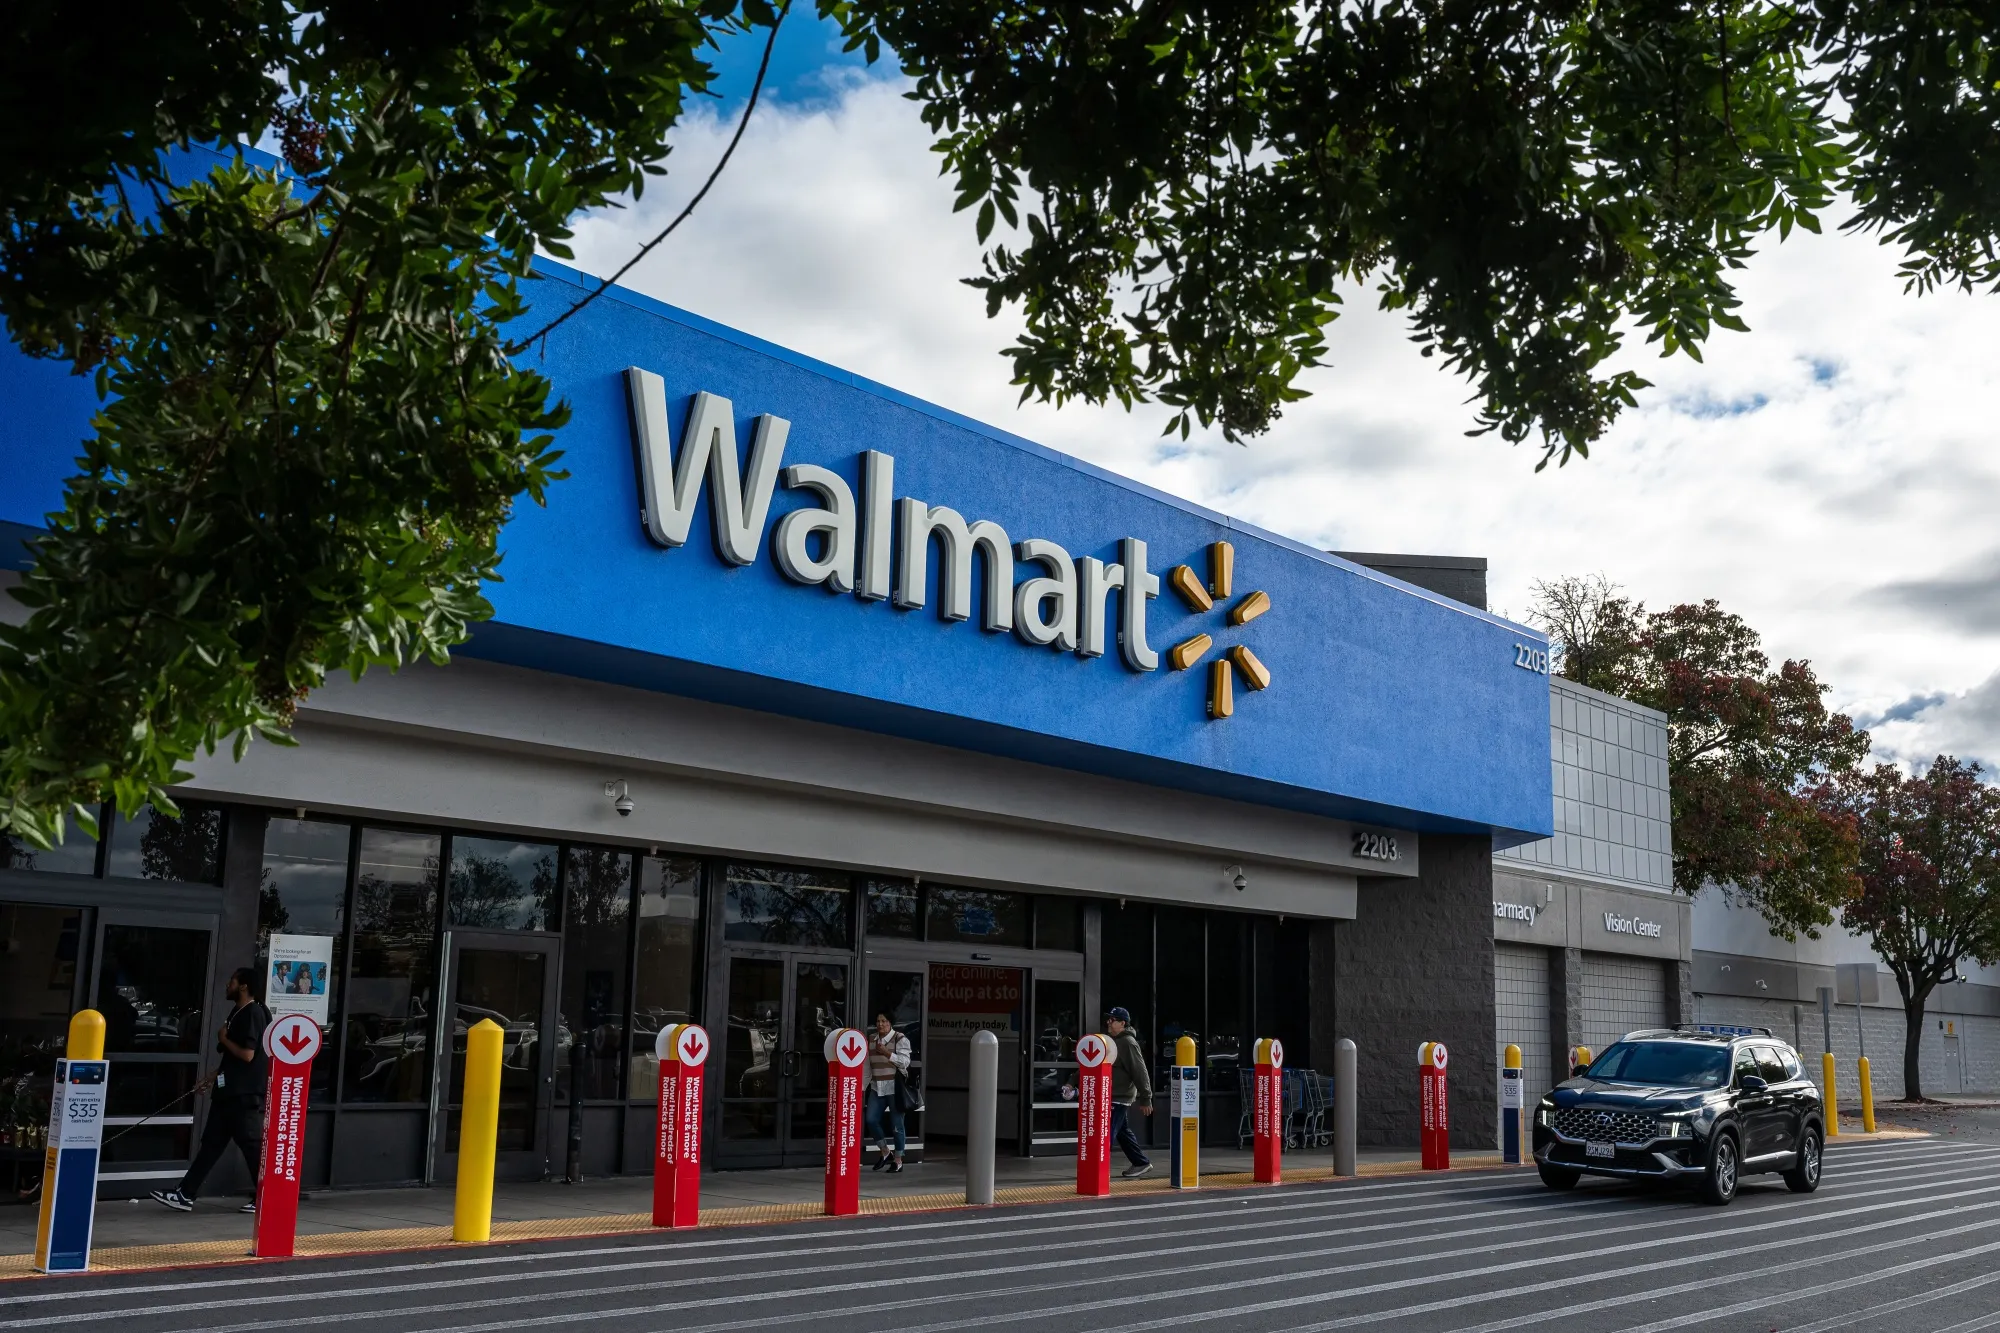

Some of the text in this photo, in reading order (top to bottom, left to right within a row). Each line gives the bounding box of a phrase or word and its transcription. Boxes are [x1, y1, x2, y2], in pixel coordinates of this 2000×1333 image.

[623, 365, 1160, 673] Walmart
[1515, 642, 1548, 675] 2203
[1360, 832, 1398, 861] 2203
[1493, 901, 1536, 927] armacy
[1604, 912, 1662, 938] Vision Center
[931, 966, 958, 980] rder
[977, 986, 992, 1000] at
[928, 1018, 1008, 1031] Walmart App today.
[68, 1102, 98, 1119] $35
[278, 1076, 292, 1132] Rollbacks
[661, 1077, 669, 1122] Rollbacks
[684, 1077, 693, 1123] Rollbacks
[842, 1077, 850, 1118] Rollbacks
[848, 1077, 857, 1147] ¡Vaya! Cientos de
[285, 1077, 304, 1181] Wow! Hundreds of
[667, 1105, 675, 1152] Hundreds
[691, 1077, 700, 1163] Wow! Hundreds of
[274, 1143, 285, 1174] more
[667, 1153, 673, 1164] of
